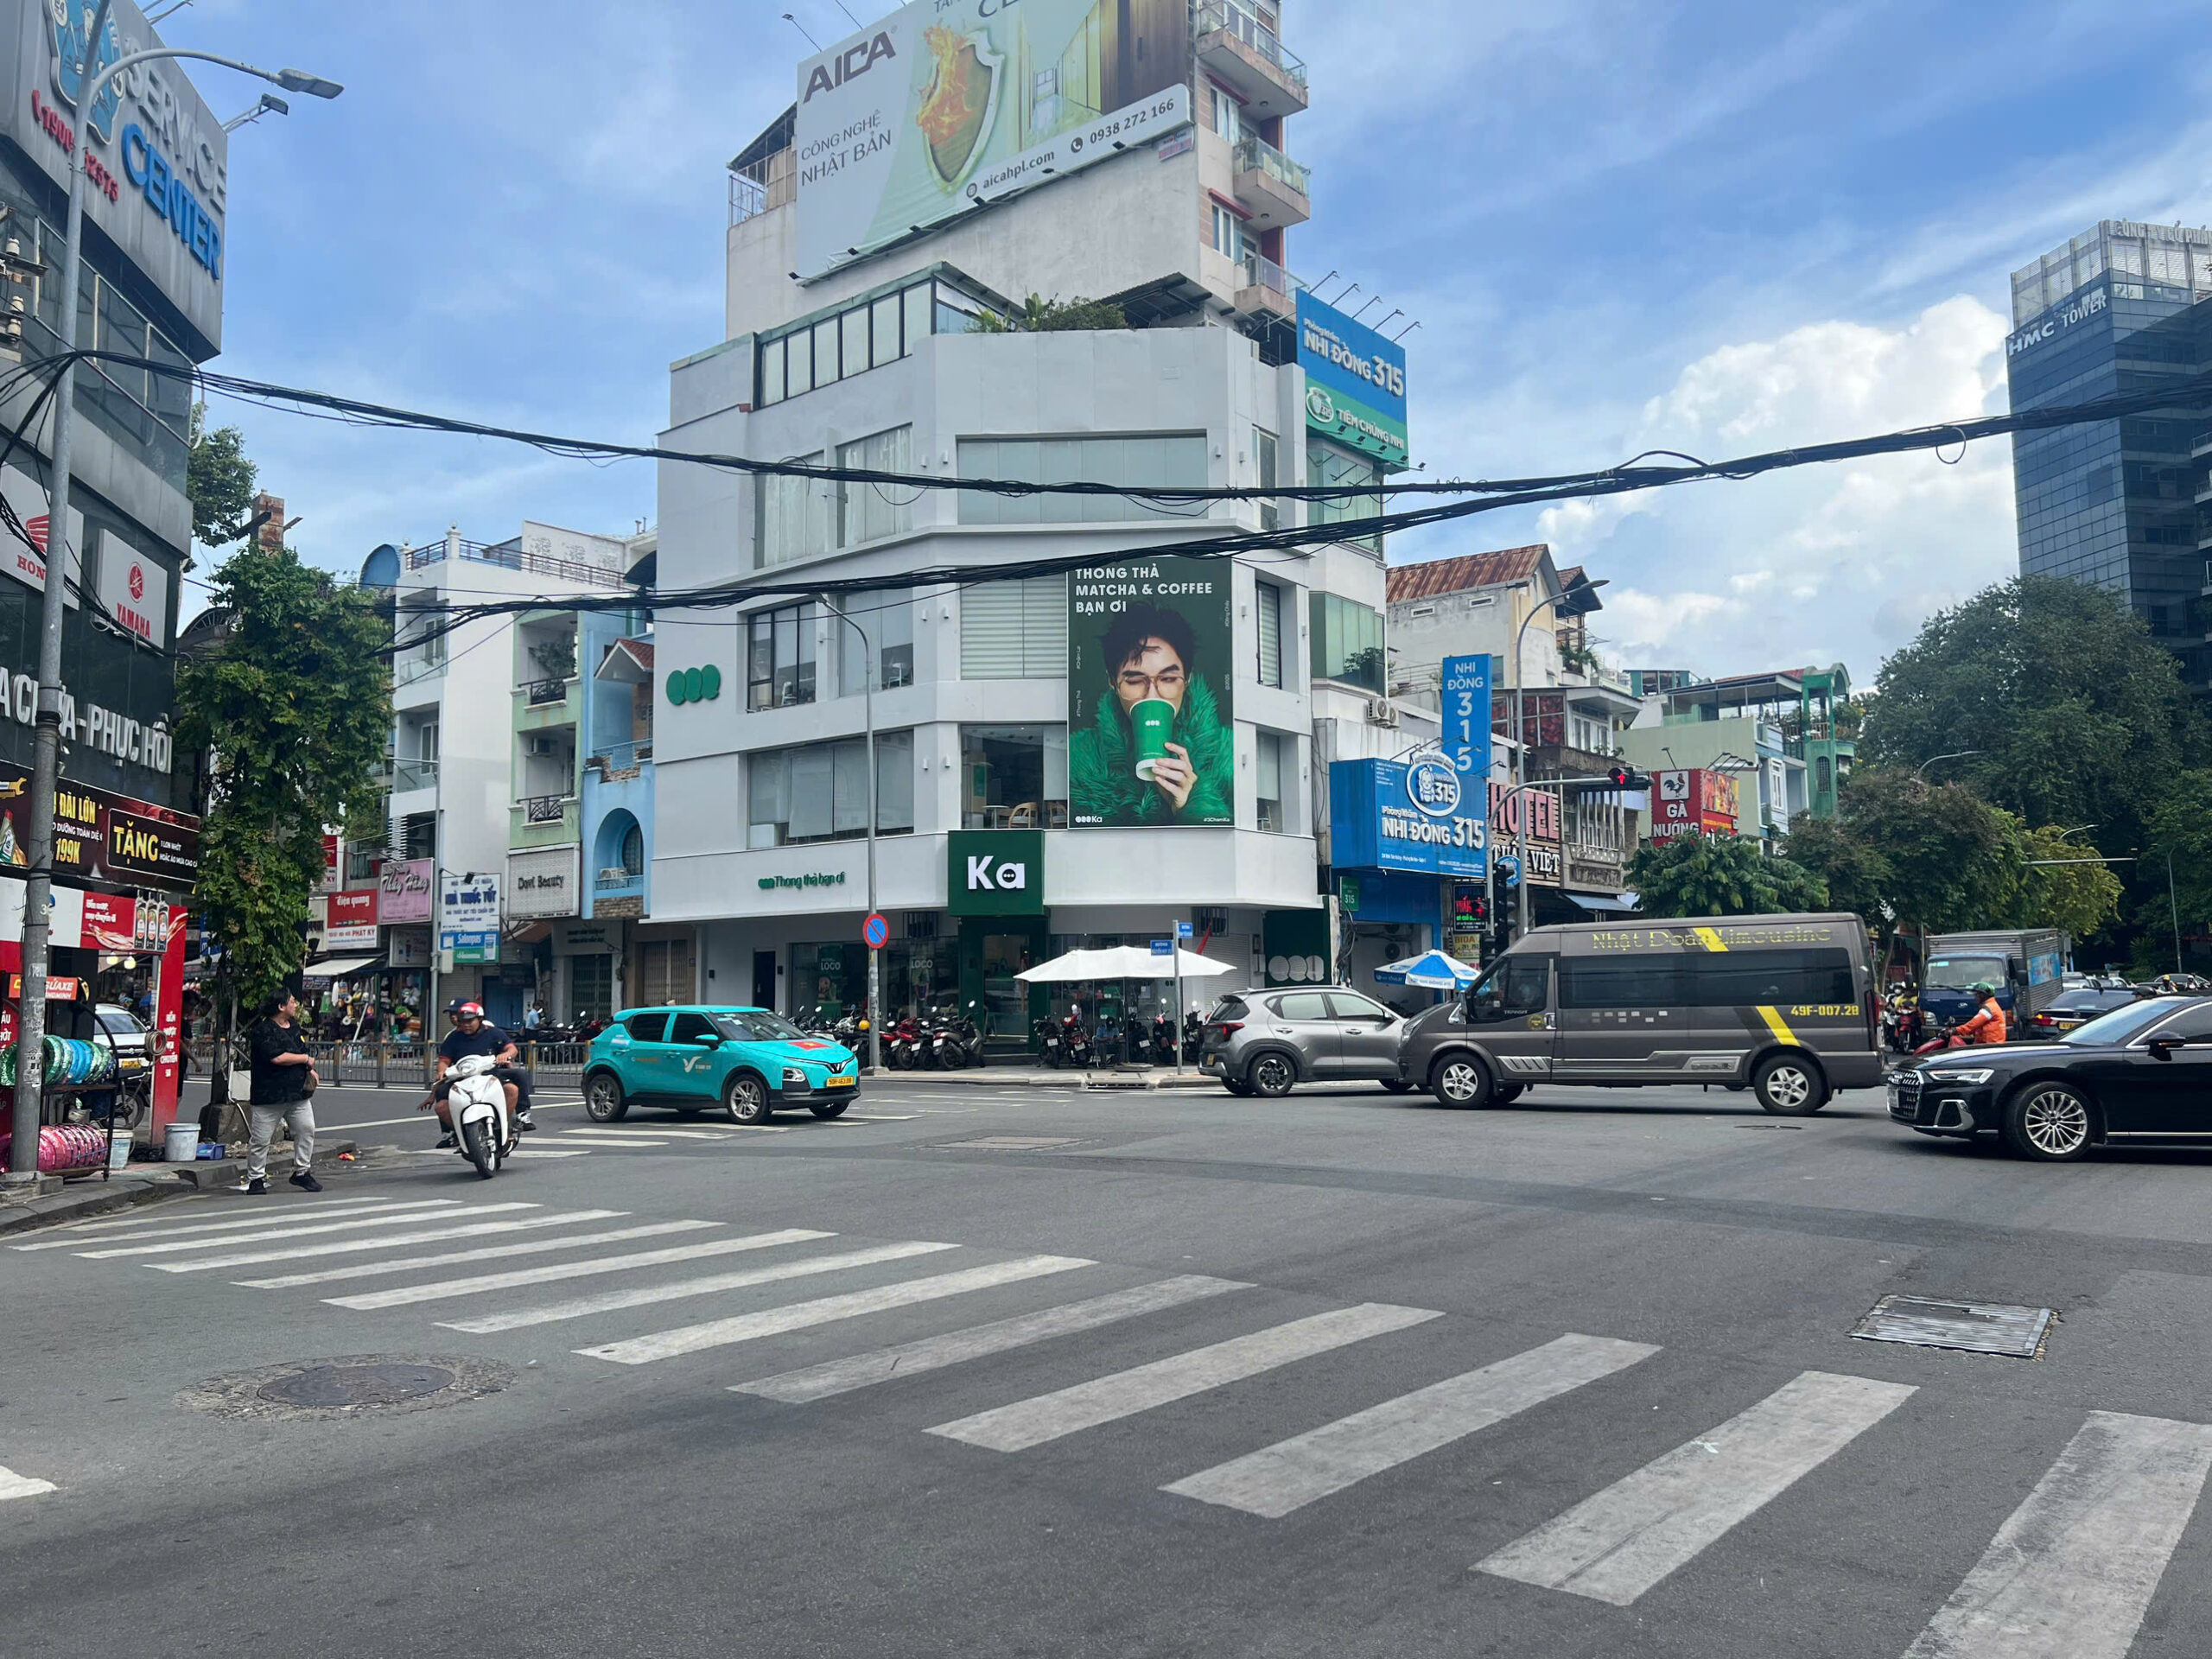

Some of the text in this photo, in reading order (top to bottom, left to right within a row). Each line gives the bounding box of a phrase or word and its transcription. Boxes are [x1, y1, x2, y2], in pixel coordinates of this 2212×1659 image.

[804, 31, 896, 104] AICA
[801, 109, 881, 161] CÔNG NGHỆ
[1090, 98, 1174, 145] 0938 272 166
[801, 130, 892, 187] NHẬT BẢN
[982, 150, 1055, 189] aicahpl.com
[121, 123, 221, 280] CENTER
[2009, 294, 2107, 356] HMC TOWER
[1304, 330, 1404, 397] NHI ĐỒNG 315
[1389, 431, 1404, 449] NHI
[1076, 563, 1160, 580] THONG THẢ
[1076, 582, 1212, 596] MATCHA & COFFEE
[117, 602, 150, 639] YAMAHA
[1076, 600, 1127, 616] BẠN ƠI
[1447, 676, 1484, 690] ĐỒNG
[1455, 663, 1476, 674] NHI
[86, 702, 140, 767] PHỤC
[141, 713, 172, 774] HỒI
[1434, 782, 1456, 804] 315
[1667, 800, 1688, 818] GÀ
[1490, 782, 1560, 841] HOTEL
[113, 821, 159, 864] TẶNG
[1382, 815, 1484, 849] NHI ĐỒNG 315
[56, 838, 80, 864] 199K
[1530, 846, 1560, 878] VIỆT
[968, 855, 1026, 890] Ka
[1344, 894, 1355, 904] 315
[821, 962, 842, 970] LOCO
[911, 959, 933, 969] LOCO
